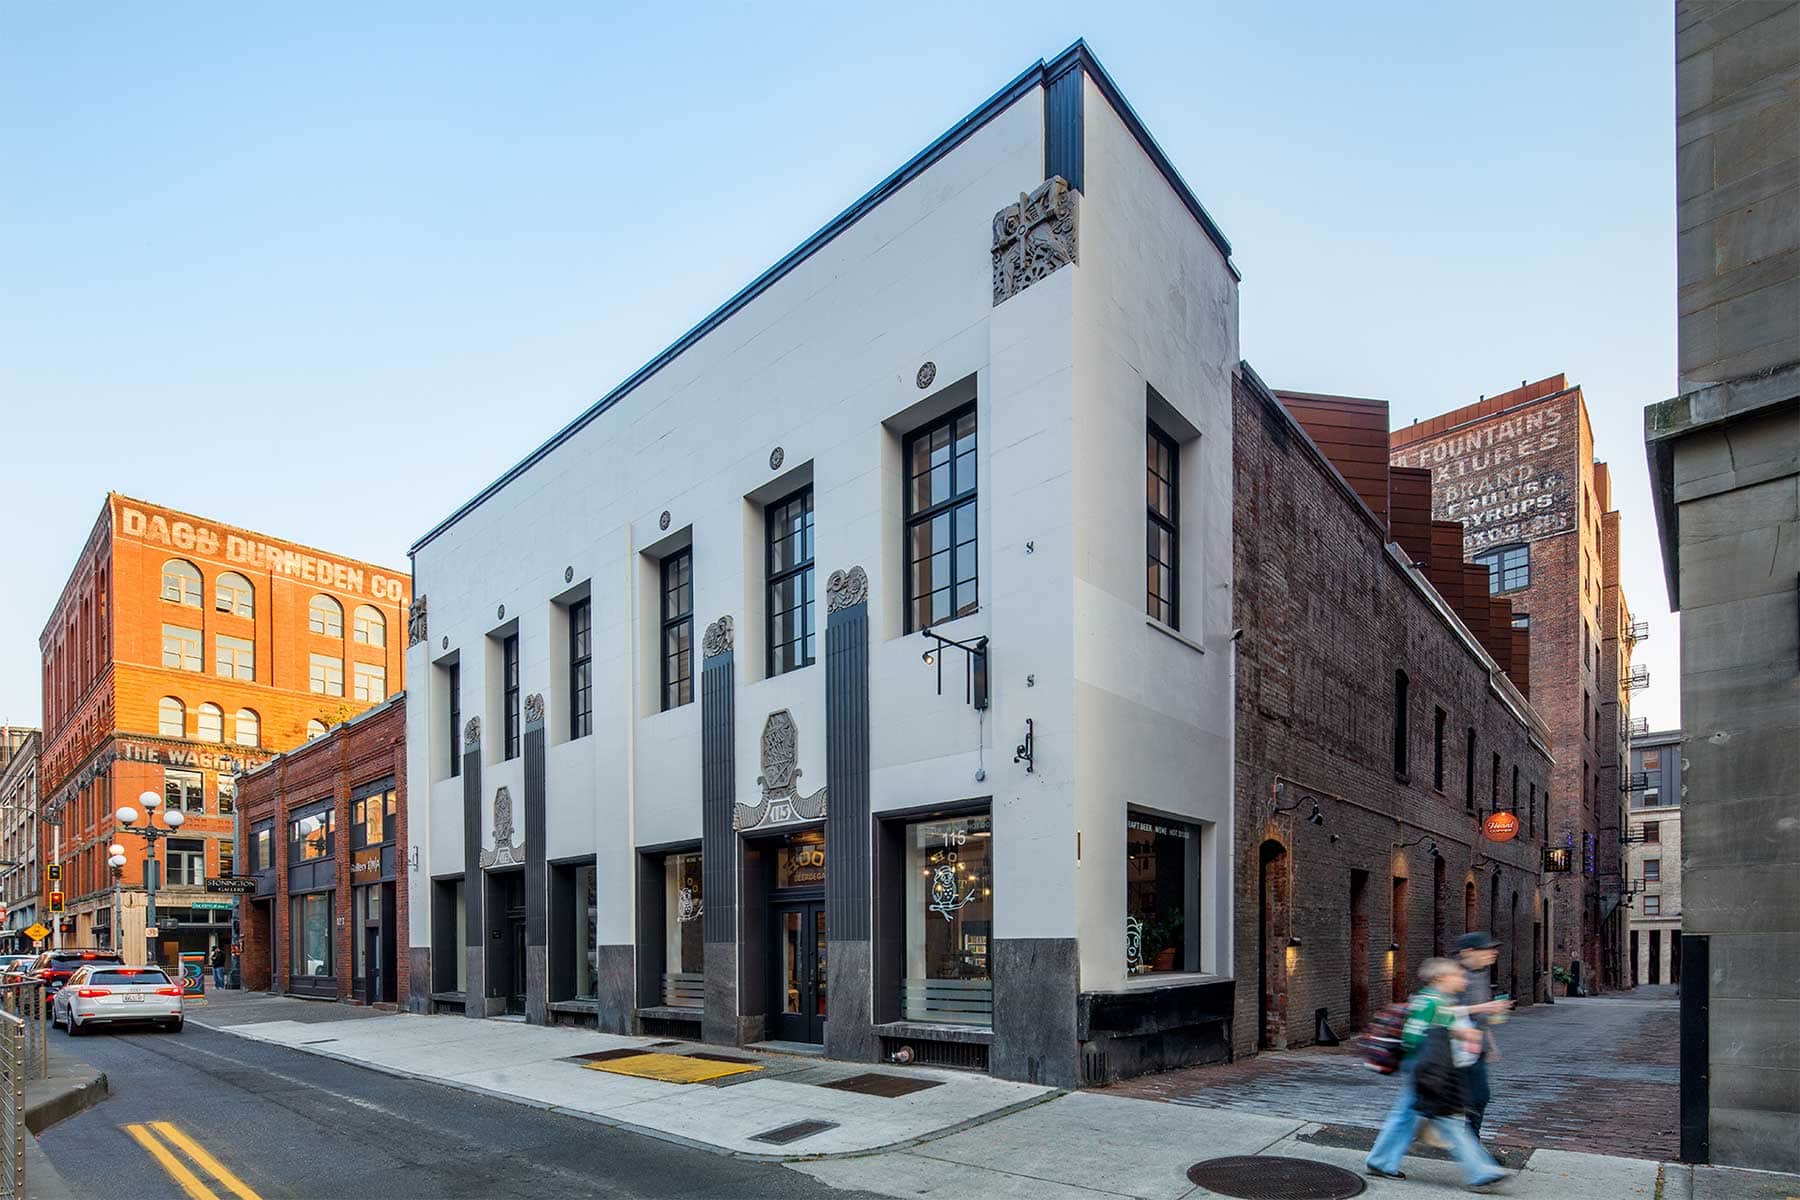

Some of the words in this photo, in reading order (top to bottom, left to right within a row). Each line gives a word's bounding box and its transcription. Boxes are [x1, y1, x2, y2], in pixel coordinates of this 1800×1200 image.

[1419, 406, 1561, 468] FOUNTAINS
[123, 743, 160, 762] THE
[942, 829, 966, 847] 115
[207, 879, 255, 888] STONINGTON
